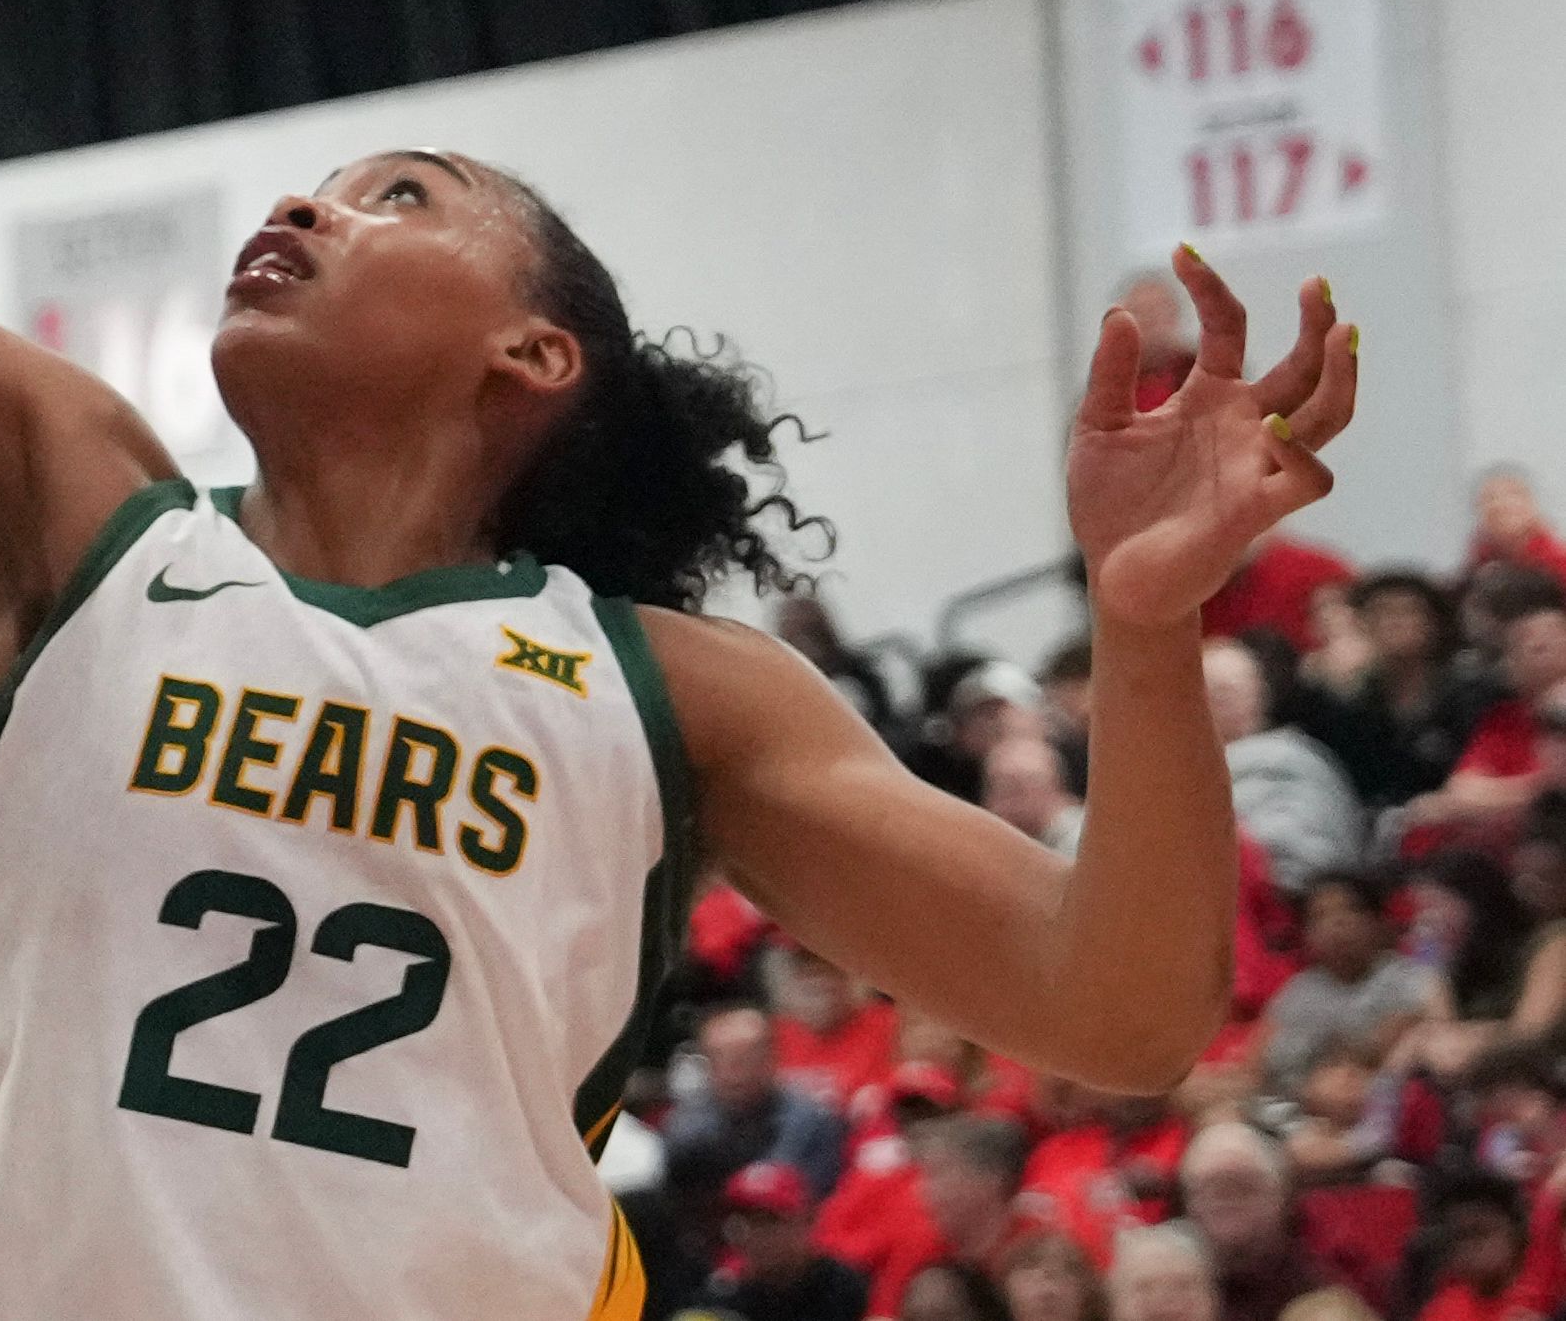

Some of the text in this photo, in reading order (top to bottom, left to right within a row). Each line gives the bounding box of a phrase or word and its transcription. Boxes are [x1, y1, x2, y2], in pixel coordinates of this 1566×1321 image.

[1187, 135, 1314, 228] 117
[496, 624, 592, 698] XII
[128, 673, 541, 878] BEARS
[118, 870, 452, 1169] 22
